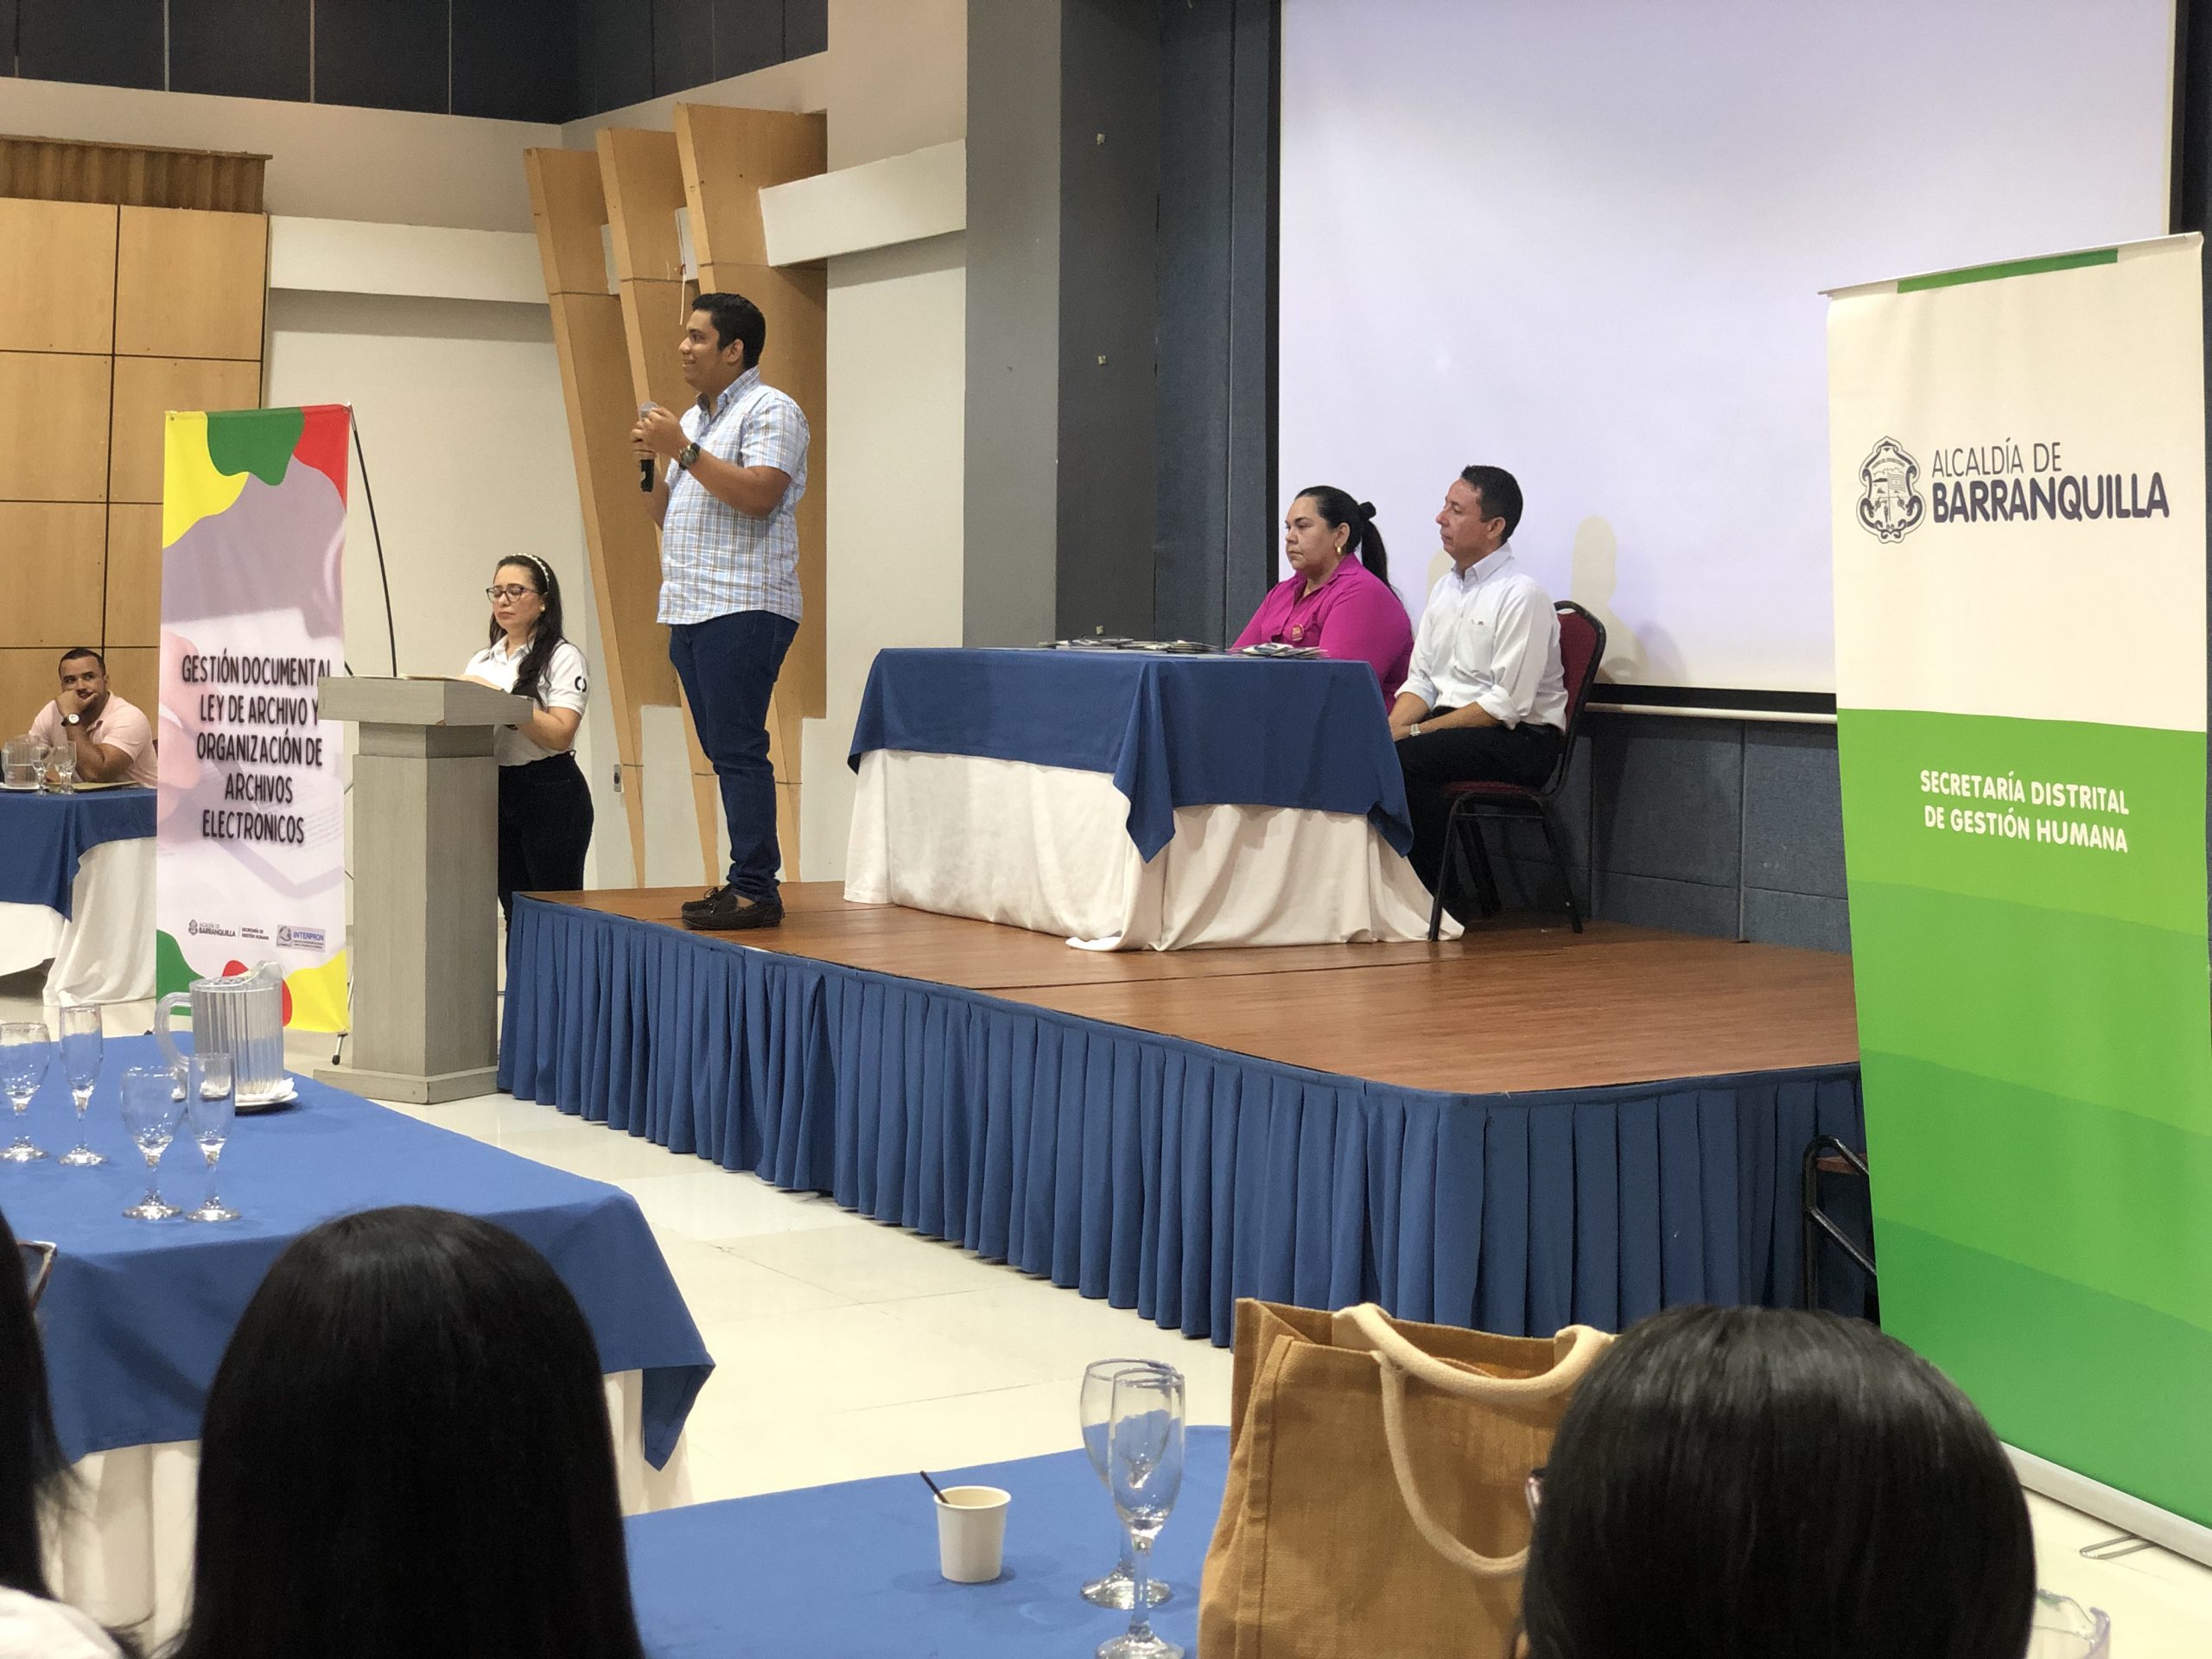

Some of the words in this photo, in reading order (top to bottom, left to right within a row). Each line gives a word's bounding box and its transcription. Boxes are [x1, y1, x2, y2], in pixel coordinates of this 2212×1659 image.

[1931, 436, 2024, 478] ALCALDÍA
[2033, 442, 2062, 473] DE
[1932, 472, 2170, 523] BARRANQUILLA
[182, 648, 238, 683] GESTIÓN
[200, 694, 225, 722] LEY
[228, 695, 245, 724] DE
[248, 696, 307, 726] ARCHIVO
[197, 728, 302, 765] ORGANIZACIÓN
[306, 737, 323, 766] DE
[225, 772, 293, 804] ARCHIVOS
[1920, 770, 2025, 804] SECRETARÍA
[2031, 781, 2130, 815] DISTRITAL
[202, 810, 304, 843] ELECTRONICOS
[1924, 804, 1945, 830] DE
[1950, 807, 2031, 840] GESTIÓN
[2037, 819, 2128, 853] HUMANA
[199, 927, 236, 938] BARRANQUILLA
